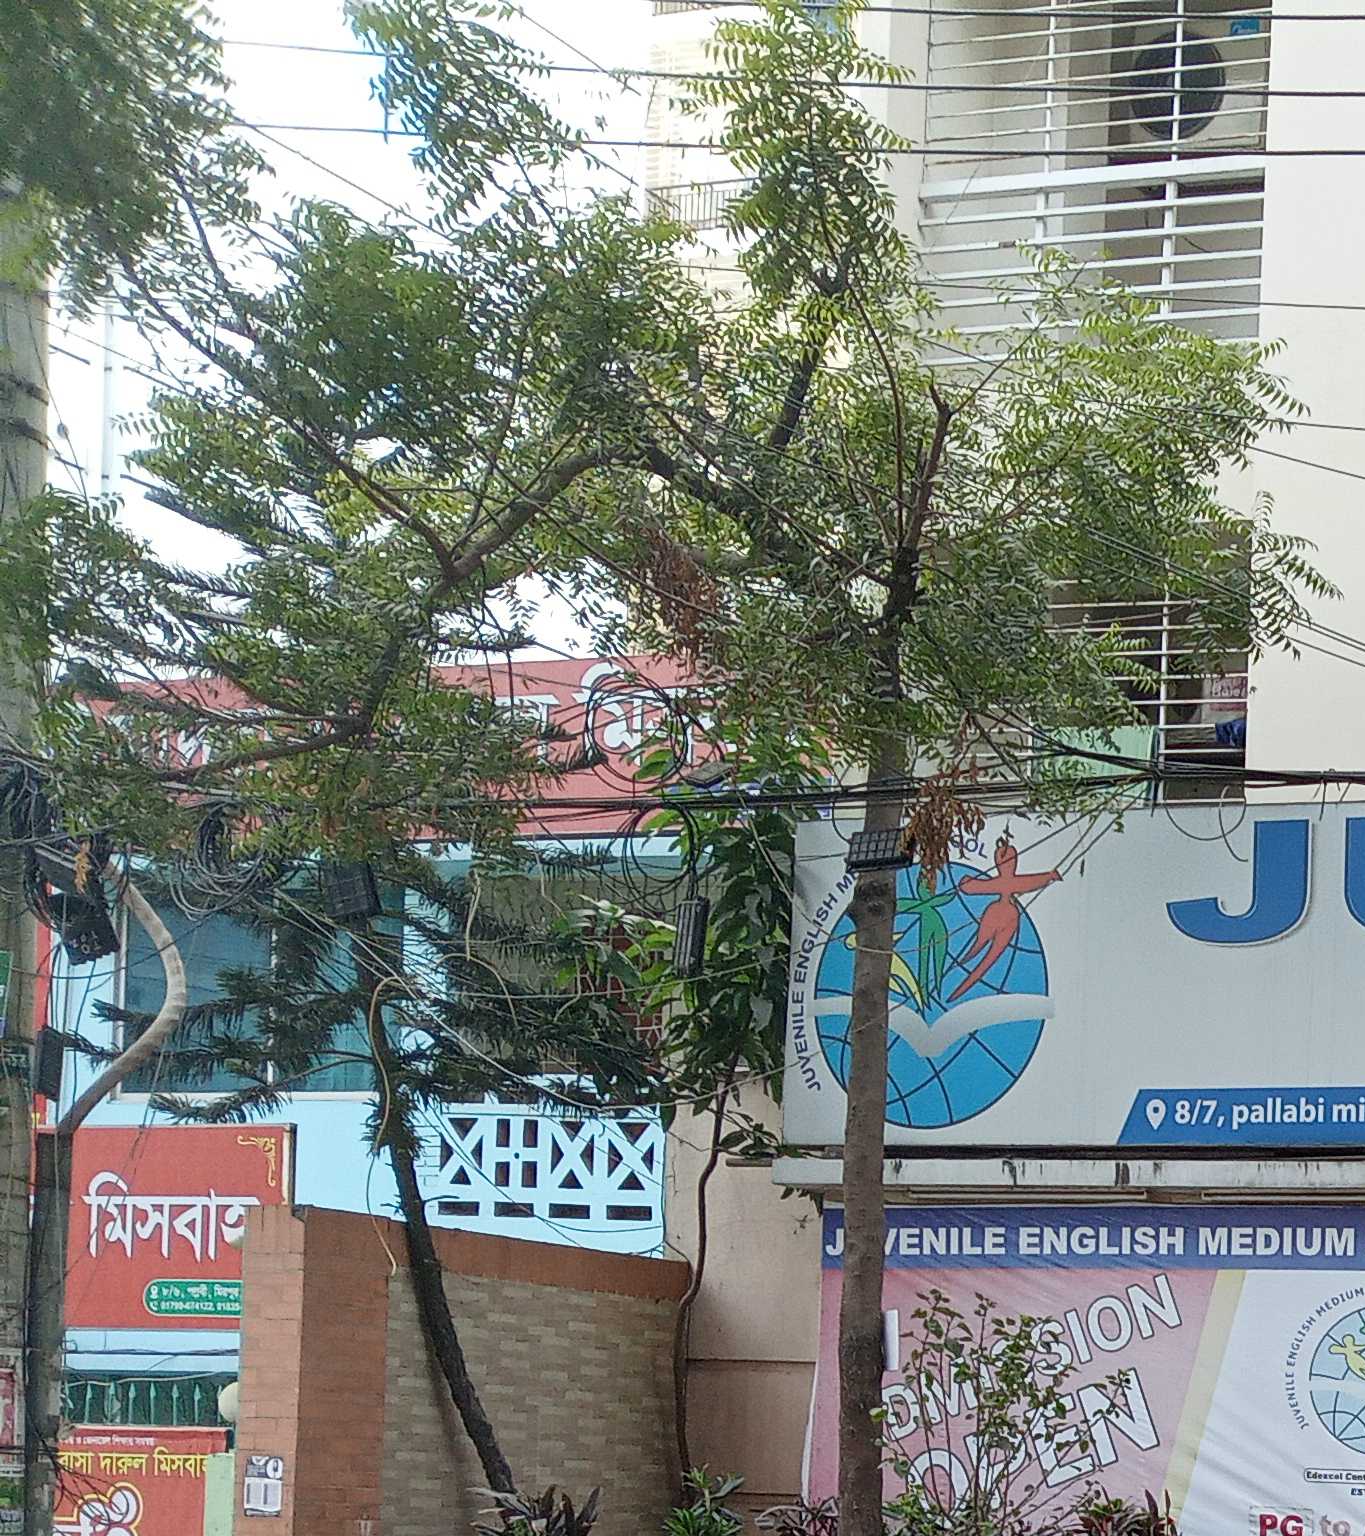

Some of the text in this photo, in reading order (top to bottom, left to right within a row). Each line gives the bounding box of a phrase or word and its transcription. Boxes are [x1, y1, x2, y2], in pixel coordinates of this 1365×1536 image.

[791, 988, 821, 1092] JUVENILE
[1174, 1100, 1226, 1129] 8/7,
[1231, 1097, 1326, 1129] pallabi
[825, 1226, 1006, 1256] JVENILE
[1018, 1225, 1185, 1256] ENGLISH
[1198, 1226, 1355, 1258] MEDIUM
